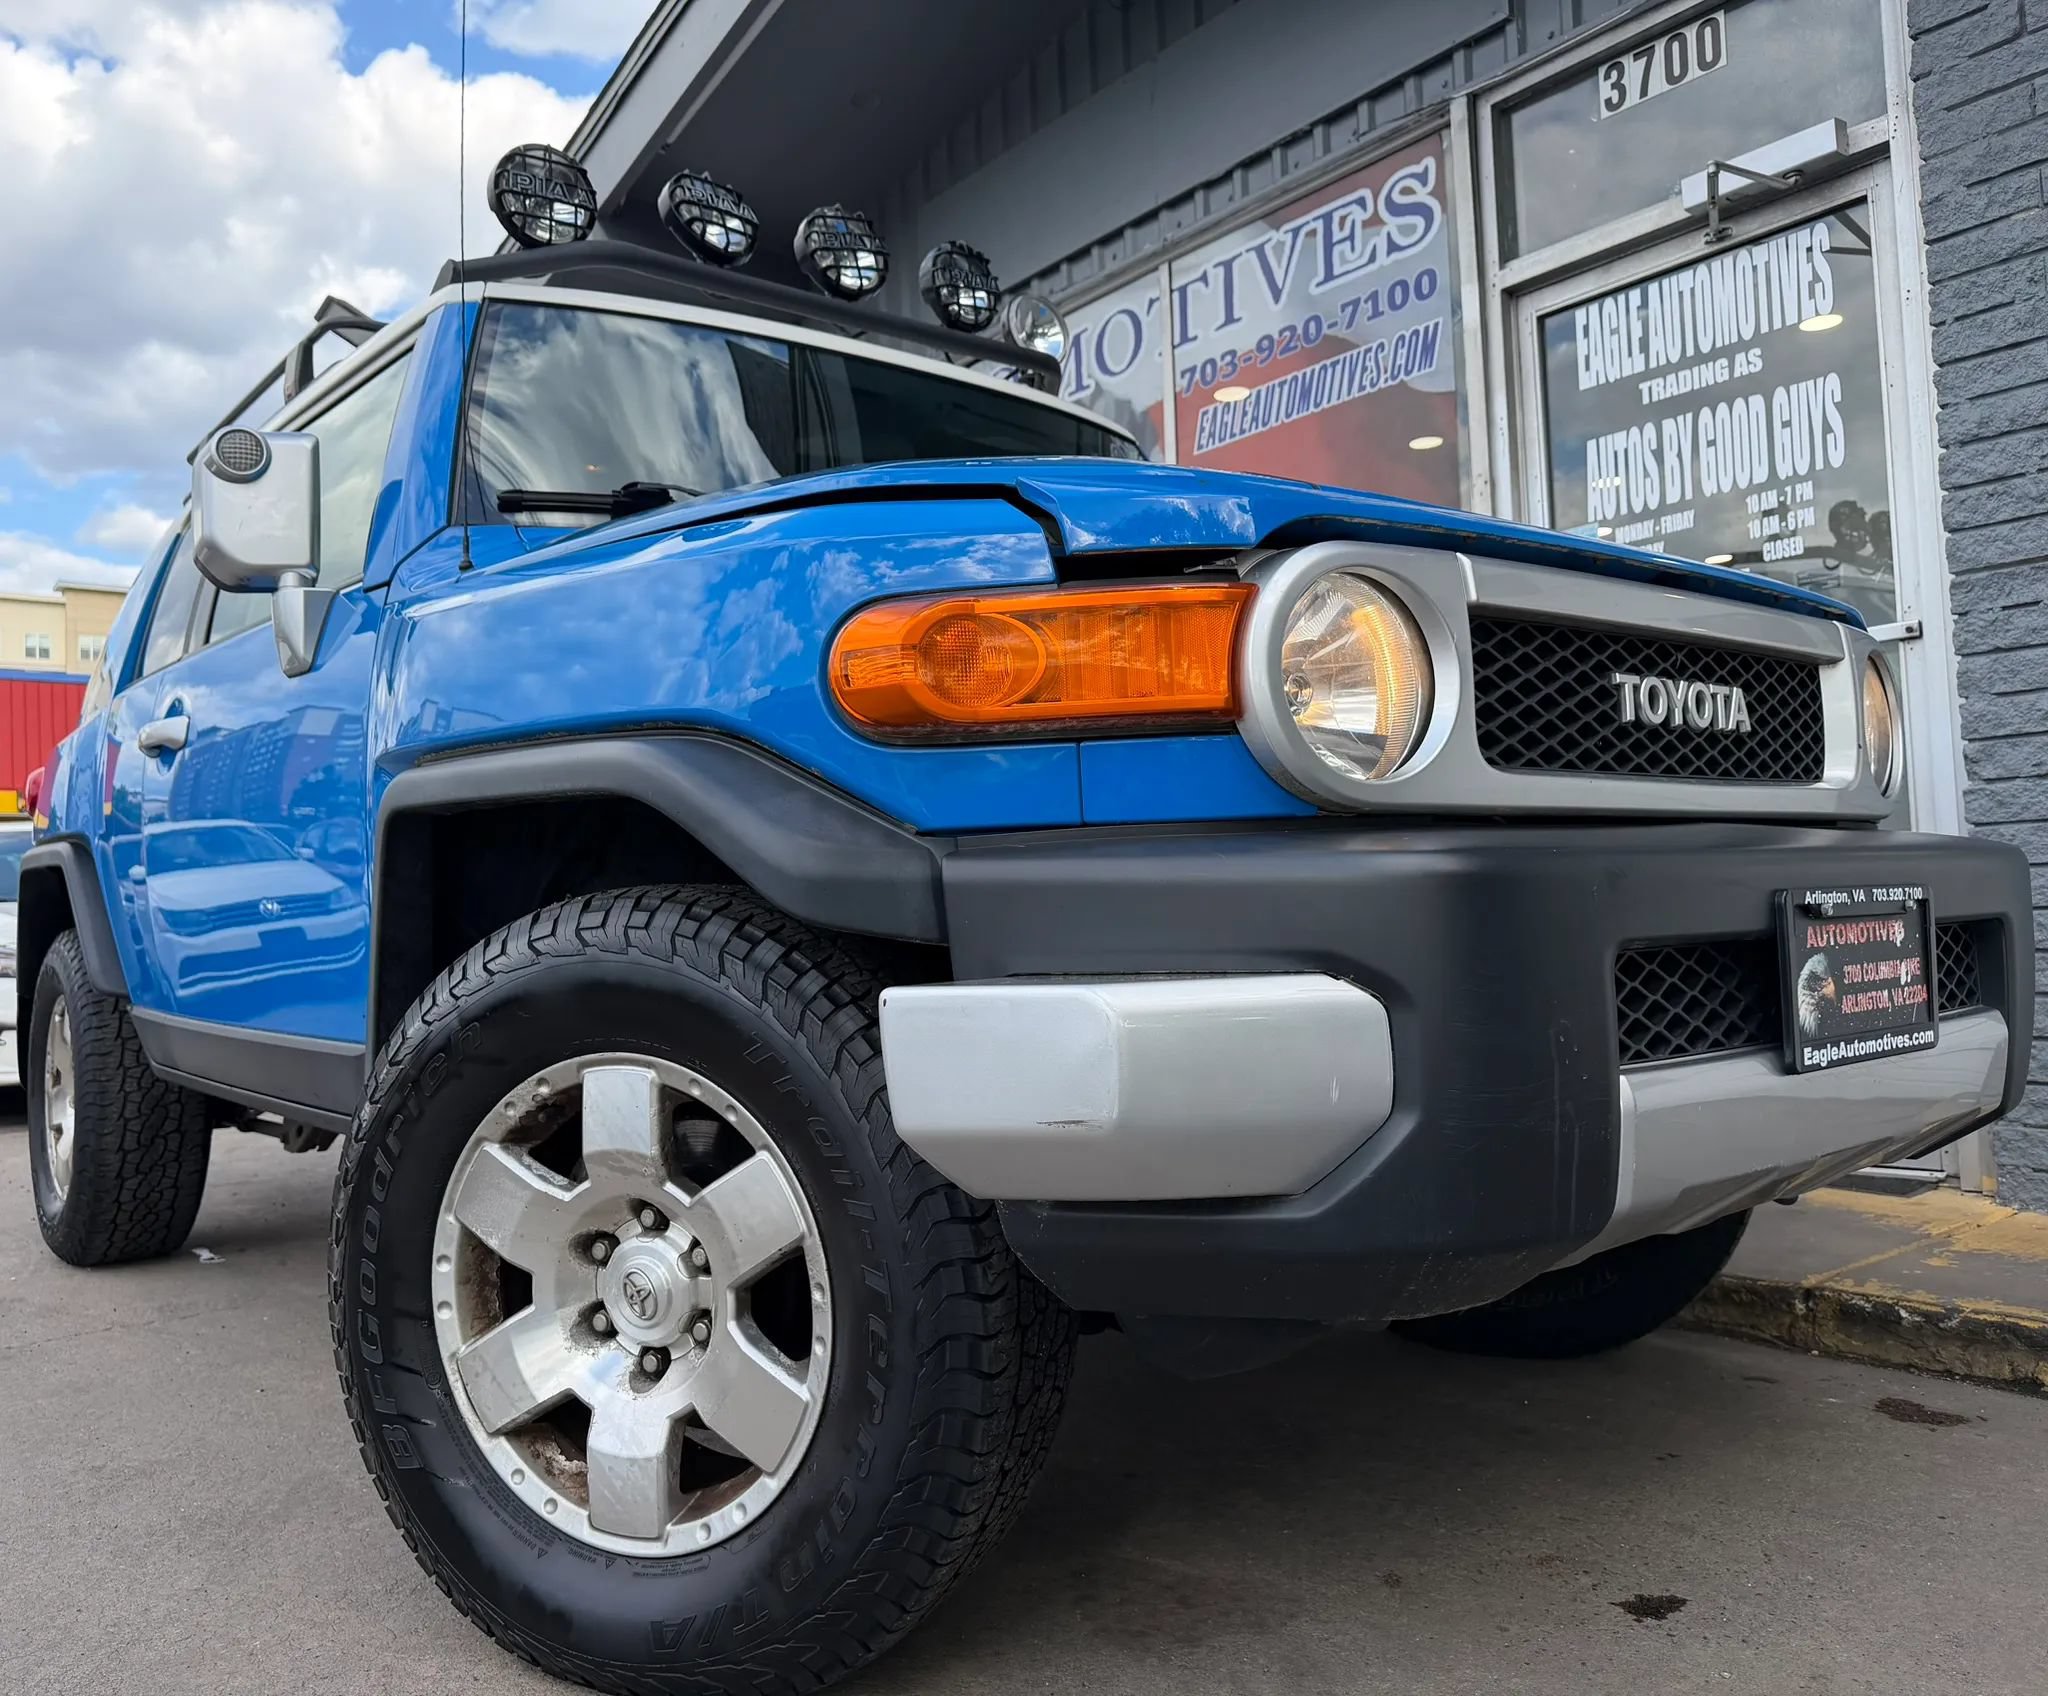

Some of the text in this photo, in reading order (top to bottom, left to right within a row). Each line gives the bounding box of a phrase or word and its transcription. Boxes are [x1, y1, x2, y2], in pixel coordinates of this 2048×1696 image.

[1603, 16, 1722, 113] 3700
[509, 170, 597, 212] PIAA
[1574, 222, 1835, 391] EAGLE AUTOMOTIVES
[1180, 267, 1438, 397] 703-920-7100
[1196, 320, 1442, 453] EAGLEAUTOMOTIVES.COM
[1638, 347, 1764, 405] TRADING AS
[1586, 372, 1846, 523] AUTOS BY GOOD GUYS
[1745, 494, 1760, 515] 10
[1760, 489, 1778, 511] AM
[1784, 485, 1792, 506] 7
[1794, 480, 1814, 503] PM
[1615, 519, 1655, 545] MONDAY
[1661, 510, 1694, 535] FRIDAY
[1747, 519, 1761, 540] 10
[1762, 514, 1780, 537] AM
[1787, 511, 1795, 531] 6
[1796, 506, 1815, 529] PM
[1762, 535, 1804, 562] CLOSED
[1610, 672, 1752, 733] TOYOTA
[1804, 887, 1923, 905] Arlington, VA 703.920.7100
[1842, 963, 1862, 985] 3700
[1892, 987, 1905, 1007] VA
[1803, 1029, 1935, 1068] EagleAutomotives.com
